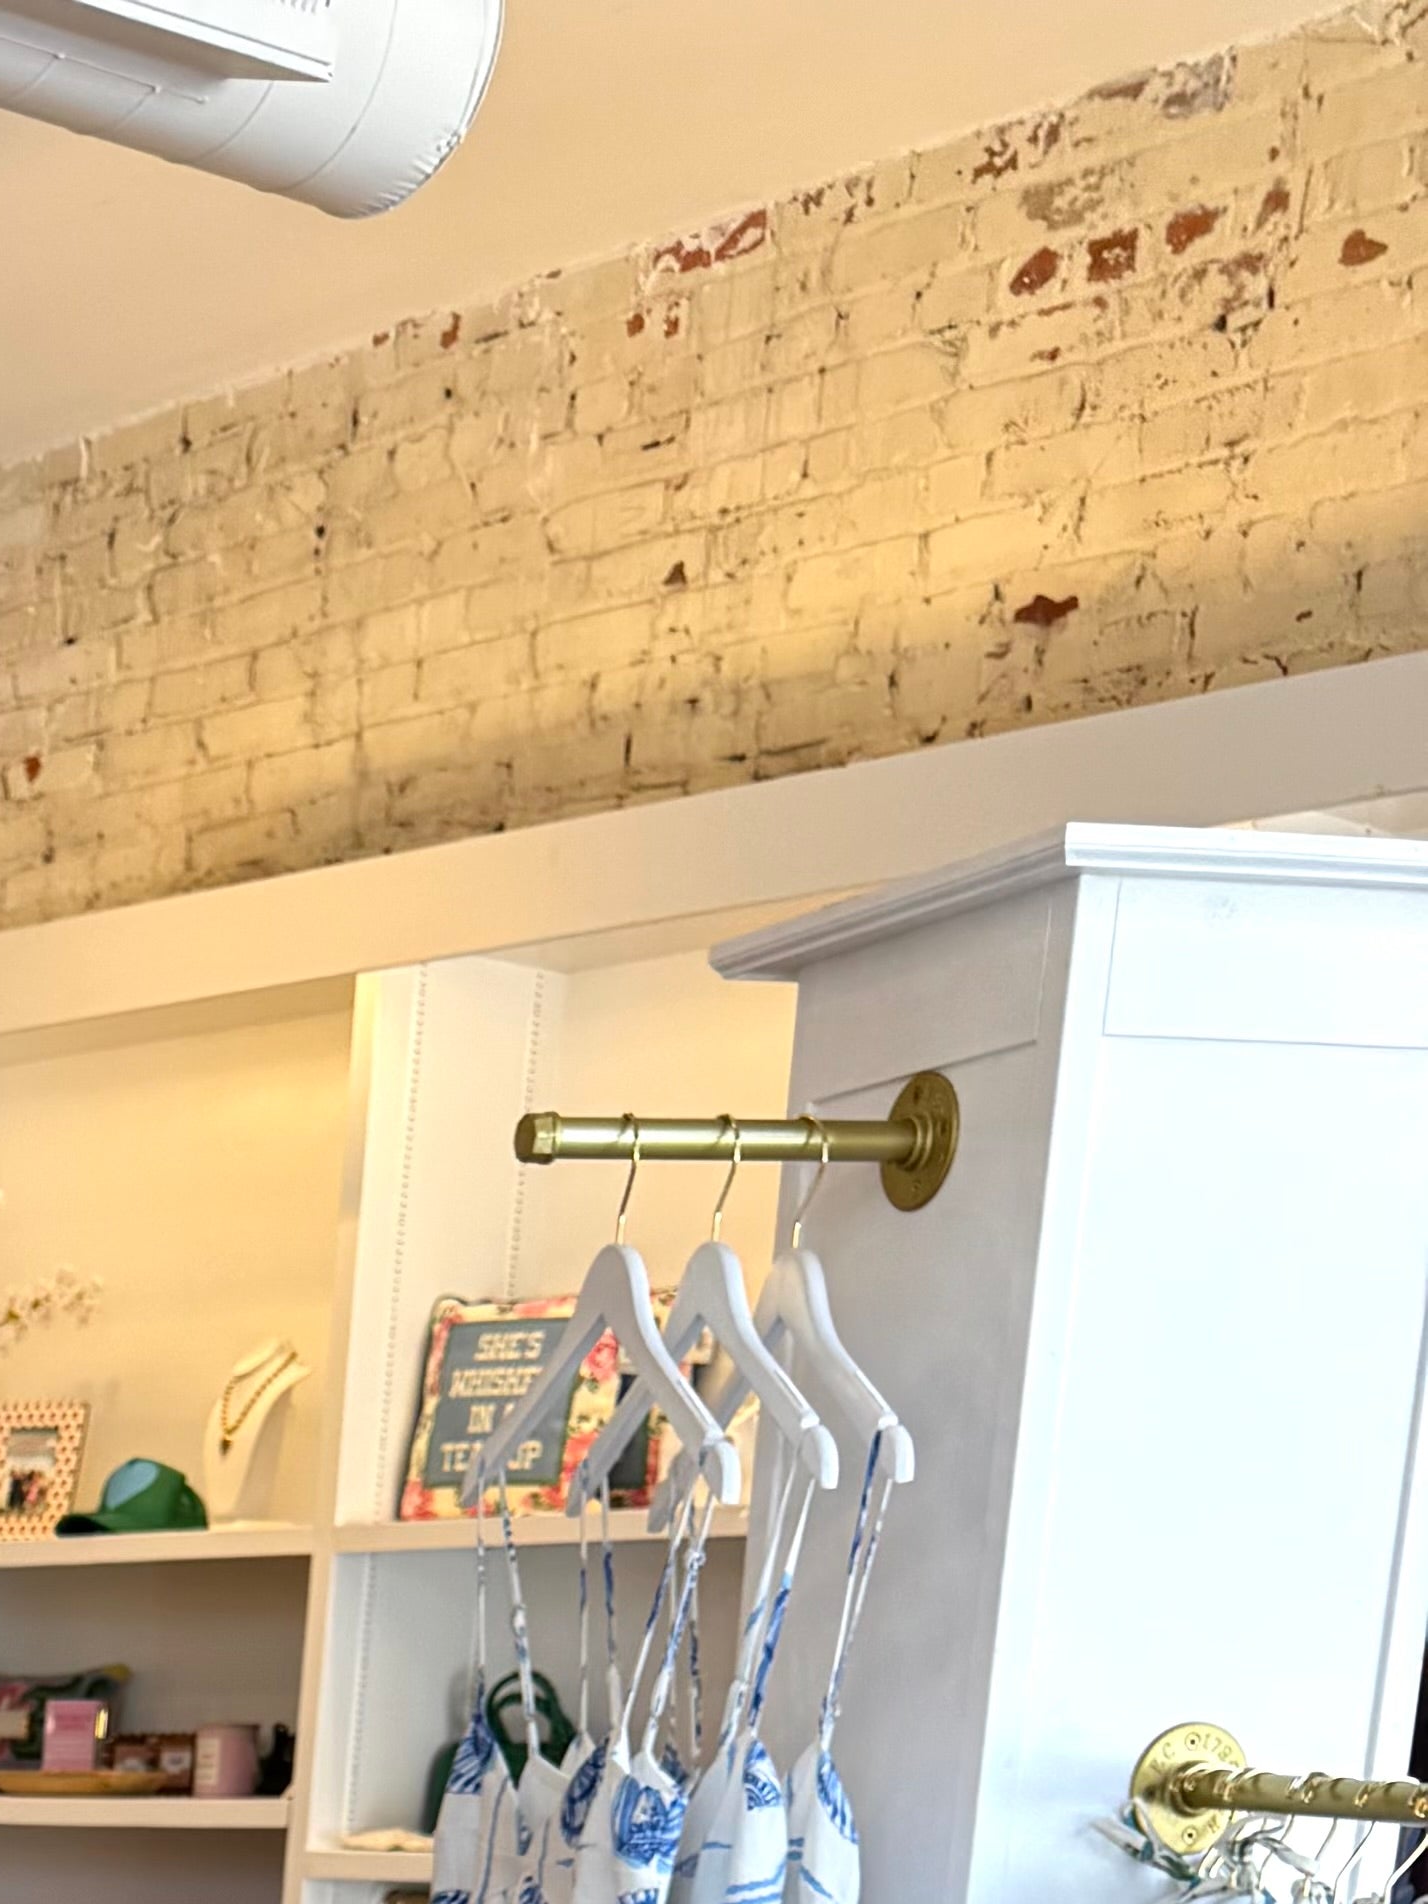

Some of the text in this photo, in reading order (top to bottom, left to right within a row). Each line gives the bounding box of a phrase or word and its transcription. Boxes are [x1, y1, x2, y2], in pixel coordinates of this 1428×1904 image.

[473, 1331, 546, 1362] SHE'S
[448, 1367, 544, 1398] WHISKE
[467, 1403, 495, 1434] IN
